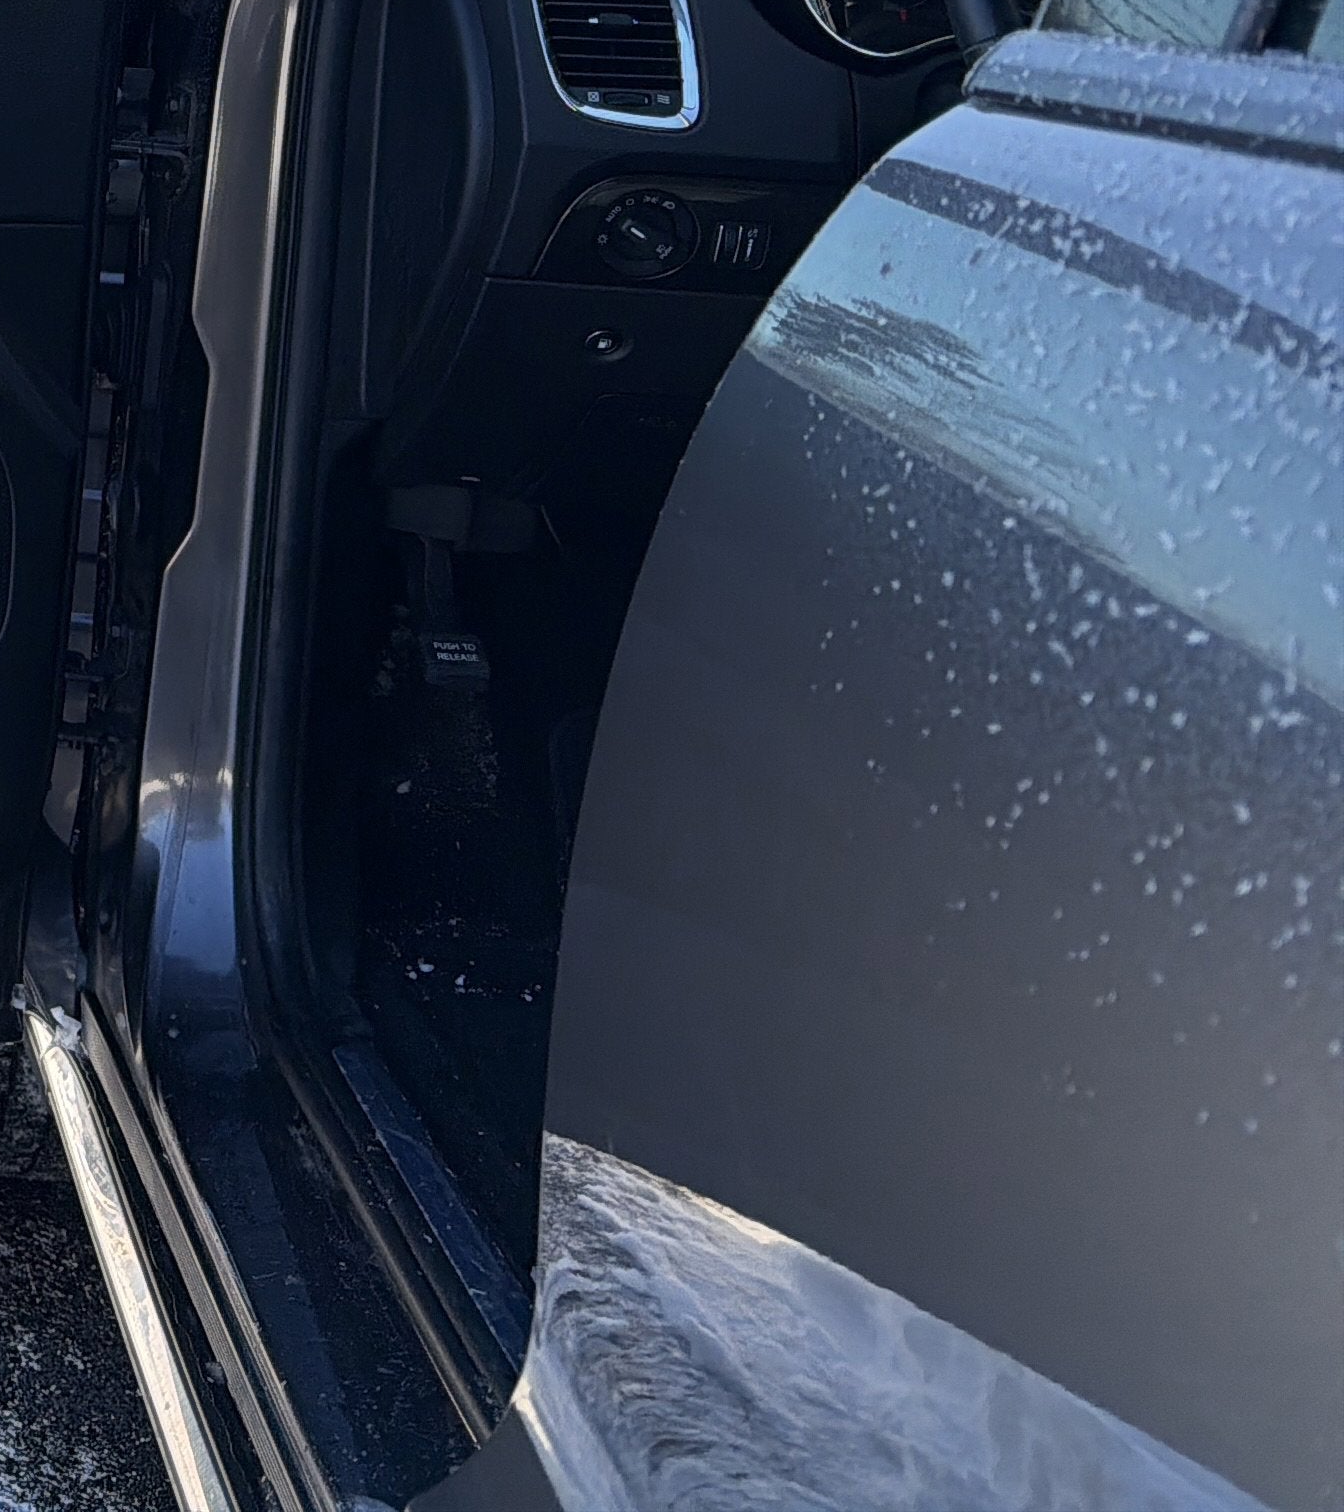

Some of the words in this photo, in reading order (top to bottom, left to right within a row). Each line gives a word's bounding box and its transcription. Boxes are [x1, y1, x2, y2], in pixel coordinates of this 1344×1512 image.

[604, 204, 622, 223] AUTO
[433, 641, 460, 651] PUSH
[462, 642, 476, 652] TO
[436, 652, 480, 662] RELEASE
